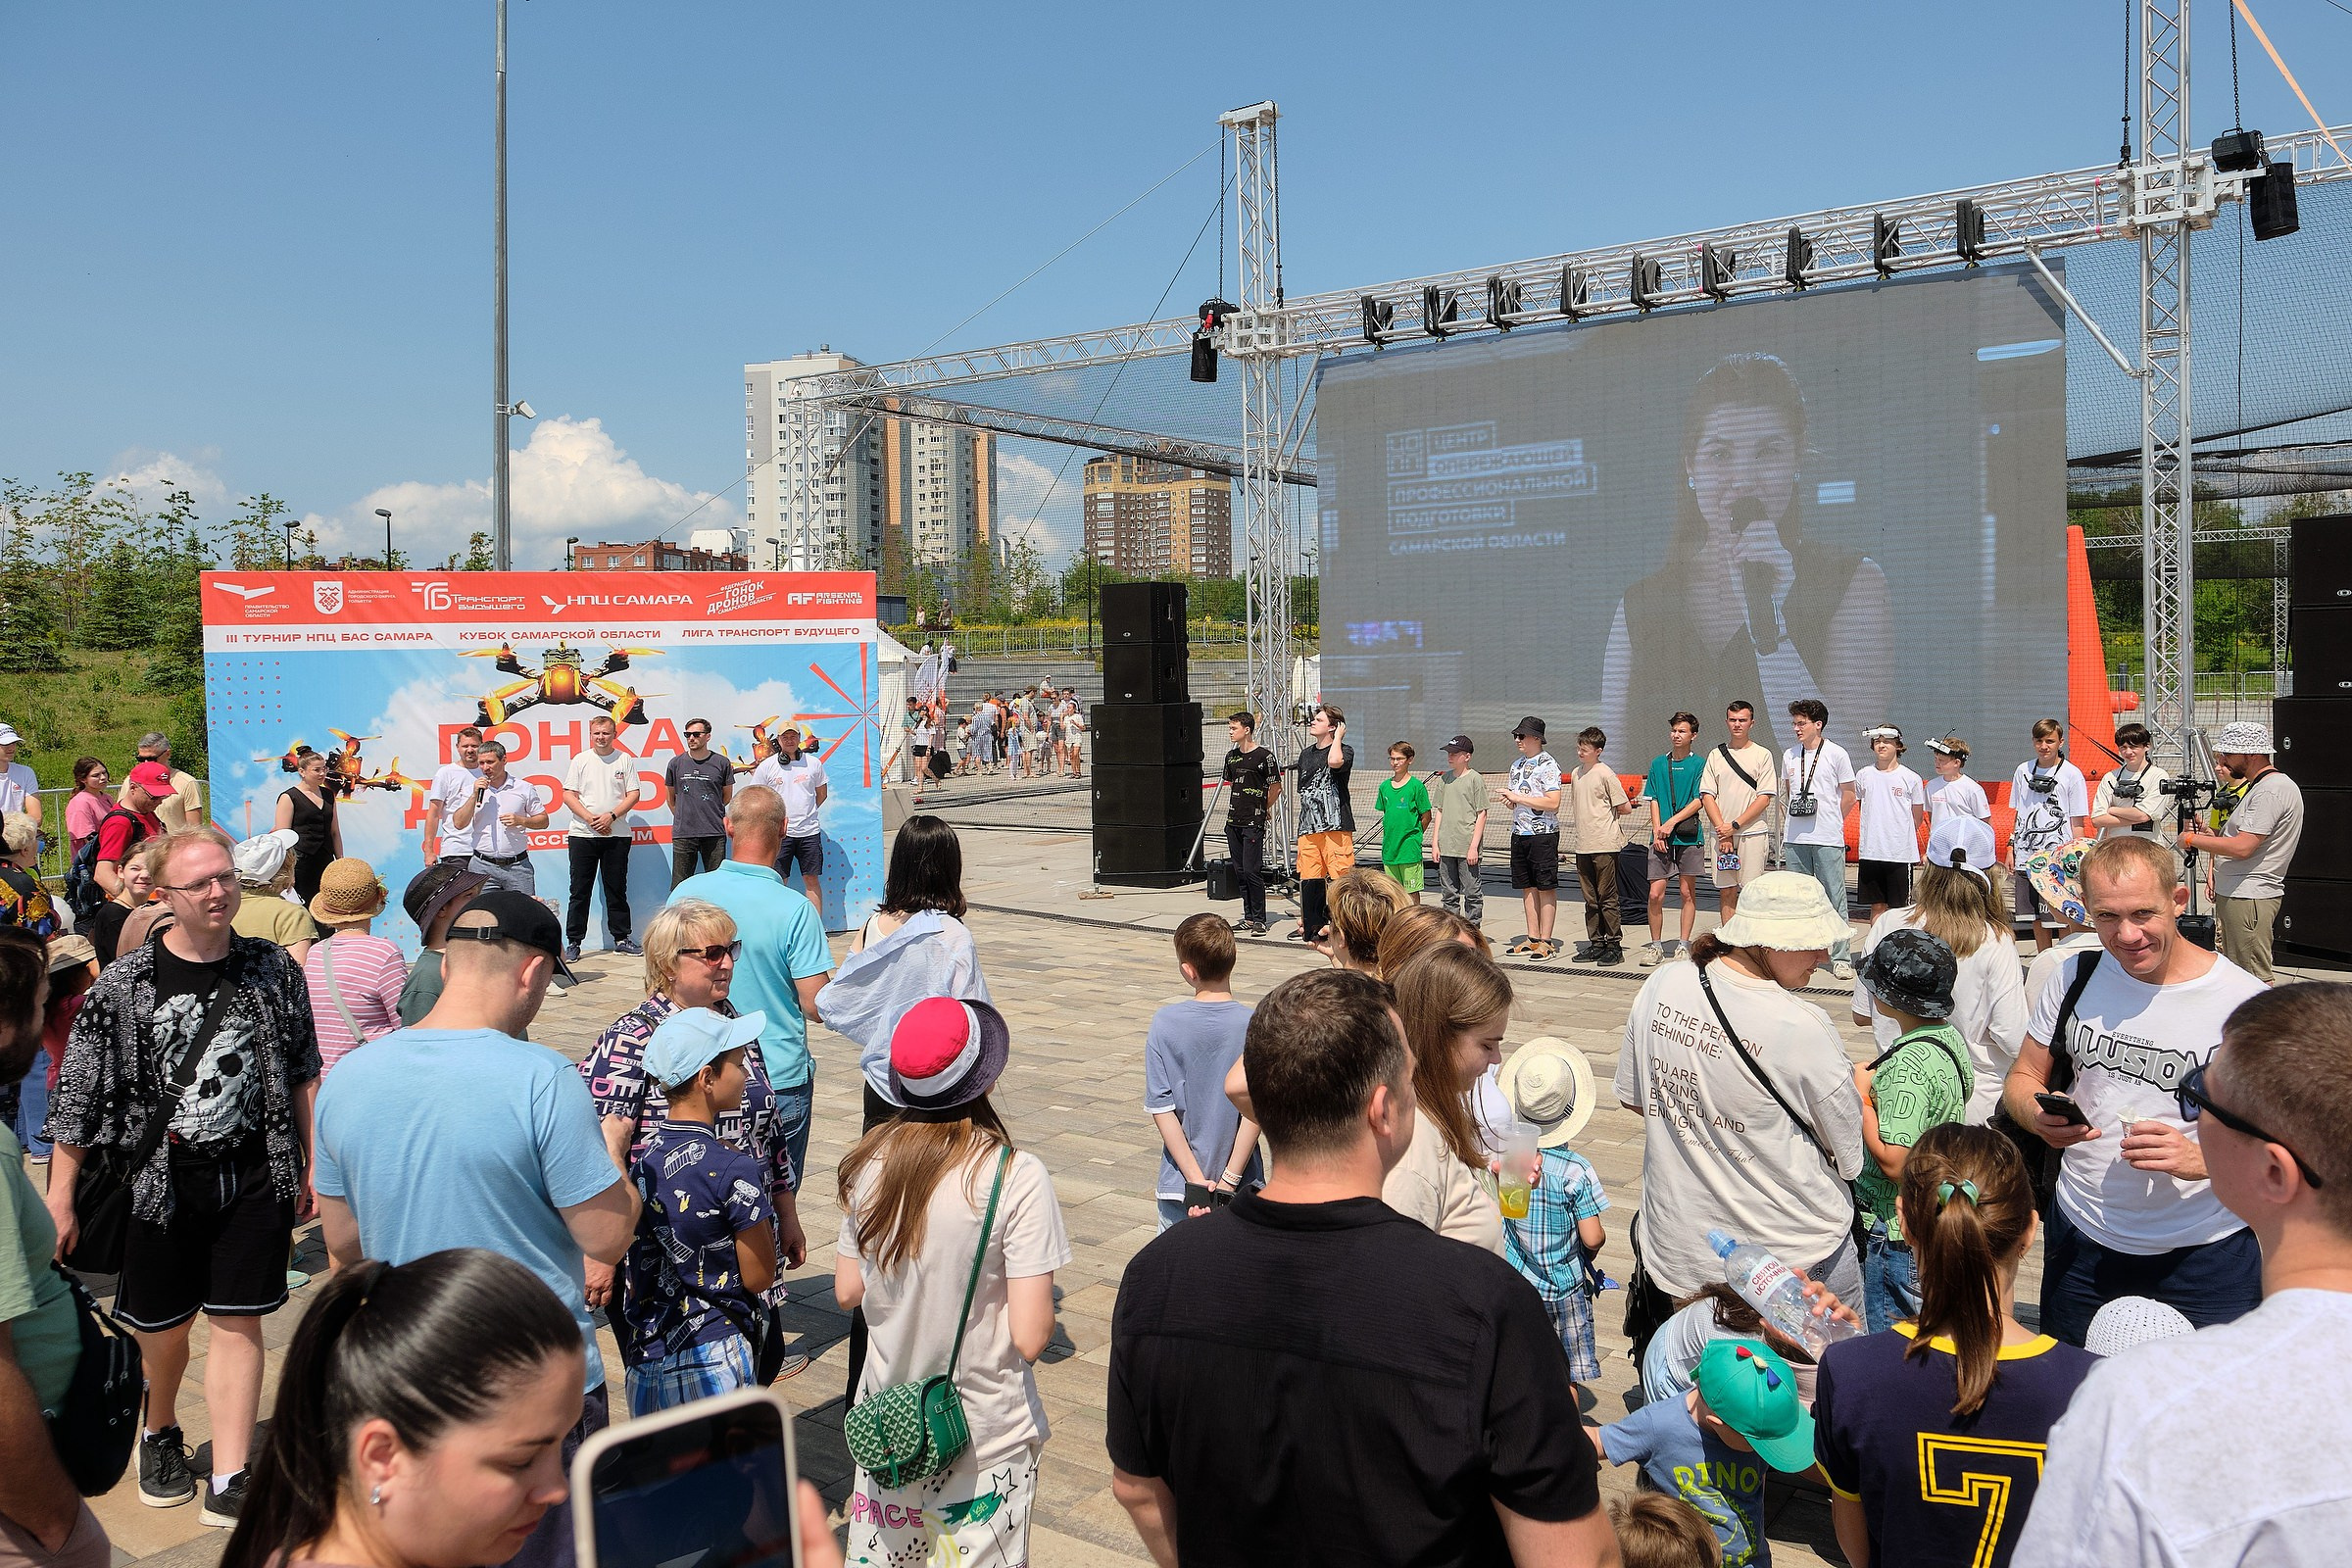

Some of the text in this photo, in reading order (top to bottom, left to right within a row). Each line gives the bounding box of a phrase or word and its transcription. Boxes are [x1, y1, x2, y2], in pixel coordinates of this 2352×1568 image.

[1435, 429, 1488, 451] ЦЕНТР
[1395, 469, 1588, 503] ПРОФЕССИОНАЛЬНОЙ
[1396, 505, 1506, 528] ПОДГОТОВКИ
[1388, 531, 1566, 556] САМАРСКОЙ ОБЛАСТИ
[720, 579, 752, 591] ФЕДЕРАЦИЯ
[725, 580, 764, 599] ГОНОК
[566, 595, 694, 607] НПЦ САМАРА
[706, 593, 755, 615] ДРОНОВ
[717, 595, 773, 614] САМАРСКОЙ ОБЛАСТИ
[243, 633, 302, 643] ТУРНИР
[307, 633, 336, 643] НПЦ
[341, 632, 369, 642] БАС
[373, 632, 433, 641] САМАРА
[460, 629, 661, 640] КУБОК САМАРСКОЙ ОБЛАСТИ
[682, 627, 859, 638] ЛИГА ТРАНСПОРТ БУДУЩЕГО
[1656, 1003, 1671, 1018] TO
[1674, 1010, 1699, 1031] THE
[1651, 1019, 1723, 1059] BEHIND ME:
[2112, 1031, 2154, 1047] EVERYTHING
[1649, 1054, 1698, 1086] YOU ARE
[2118, 1074, 2133, 1084] JUST
[1650, 1087, 1745, 1133] BEUTIFUL AND
[1673, 1461, 1760, 1494] DINO
